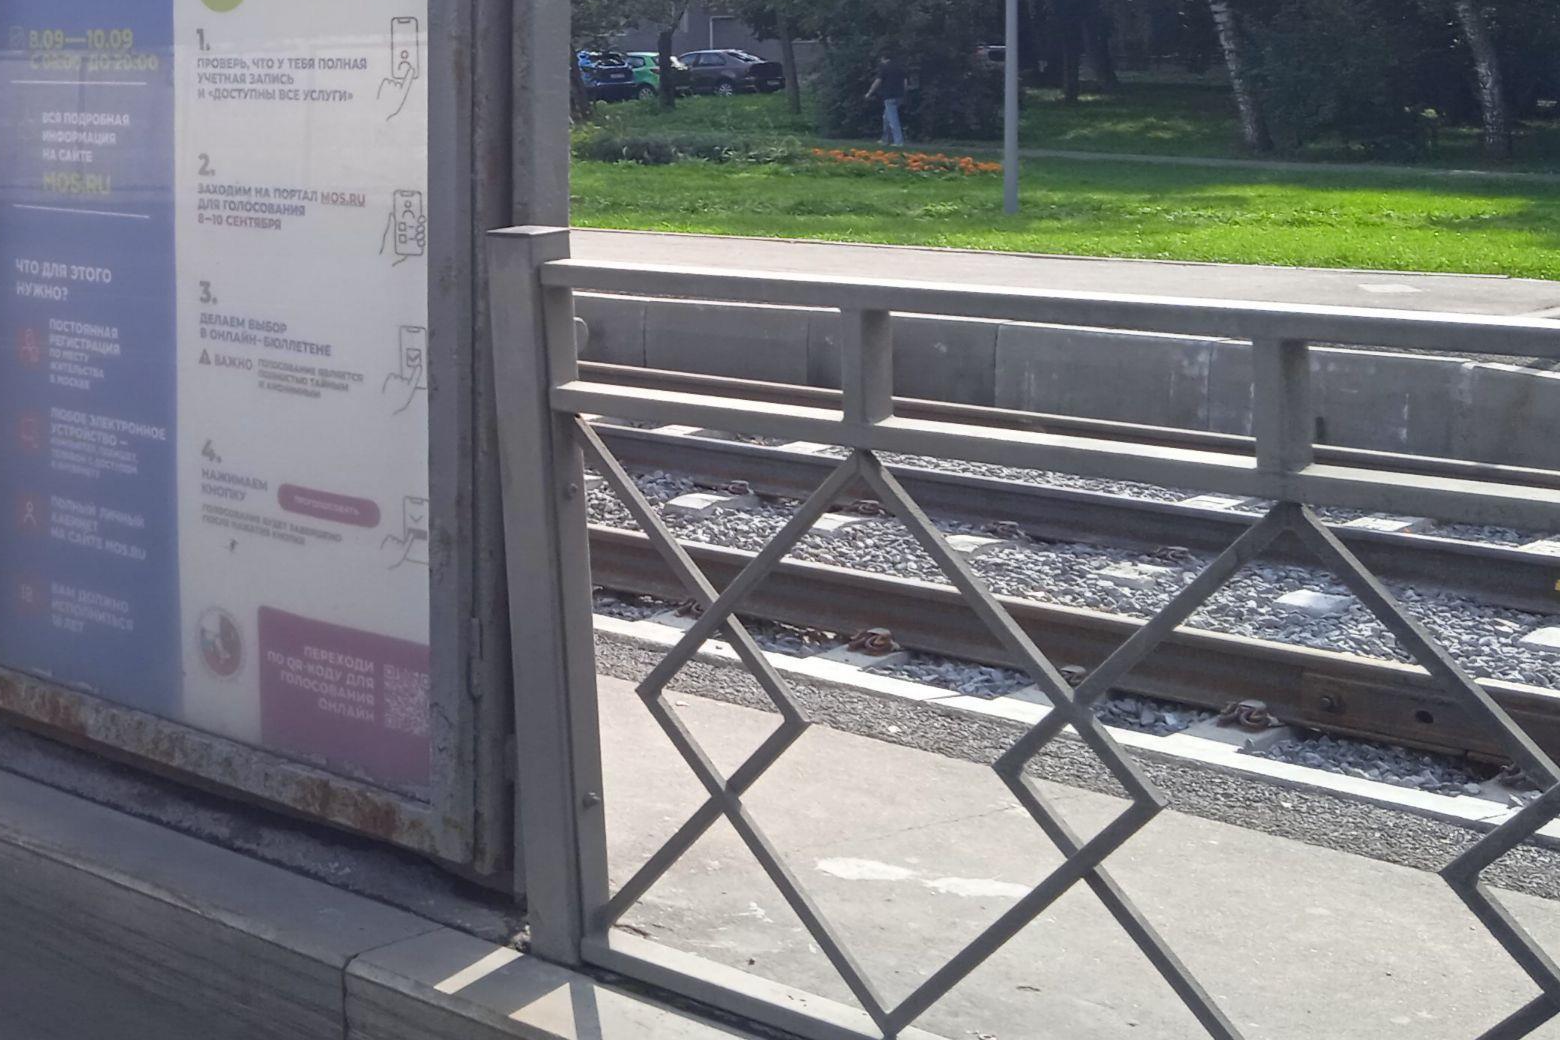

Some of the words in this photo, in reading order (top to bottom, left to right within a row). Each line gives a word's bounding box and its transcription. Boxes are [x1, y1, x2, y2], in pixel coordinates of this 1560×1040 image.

[196, 28, 210, 51] 1.
[197, 58, 250, 70] ПРОВЕРЬ,
[253, 58, 274, 69] ЧТО
[277, 58, 285, 70] У
[289, 58, 315, 70] ТЕБЯ
[318, 58, 368, 70] ПОЛНАЯ
[197, 72, 247, 85] УЧЕТНАЯ
[249, 73, 294, 85] ЗАПИСЬ
[198, 88, 205, 99] И
[279, 89, 300, 101] ВСЕ
[63, 112, 130, 126] ПОДРОБНАЯ
[42, 148, 57, 161] НА
[198, 153, 216, 177] 2.
[197, 183, 252, 198] ЗАХОДИМ
[255, 186, 271, 199] НА
[273, 188, 318, 202] ПОРТАЛ
[321, 192, 366, 208] MOS.RU
[198, 199, 220, 211] ДЛЯ
[223, 199, 306, 217] ГОЛОСОВАНИЯ
[226, 215, 282, 230] СЕНТЯБРЯ
[16, 258, 39, 274] ЧТО
[42, 262, 68, 279] ДЛЯ
[70, 265, 112, 283] ЭТОГО
[16, 280, 68, 301] НУЖНО?
[199, 280, 218, 304] 3.
[49, 318, 119, 339] ПОСТОЯННАЯ
[200, 312, 245, 328] ДЕЛАЕМ
[248, 318, 288, 335] ВЫБОР
[200, 327, 207, 339] В
[49, 333, 121, 356] РЕГИСТРАЦИЯ
[214, 354, 253, 371] ВАЖНО
[89, 413, 167, 441] ЭЛЕКТРОННОЕ
[201, 439, 222, 463] 4.
[267, 650, 284, 665] ПО
[346, 673, 375, 689] ДЛЯ
[304, 646, 375, 674] ПЕРЕХОДИ
[280, 671, 375, 707] ГОЛОСОВАНИЯ
[318, 698, 375, 723] ОНЛАЙН
